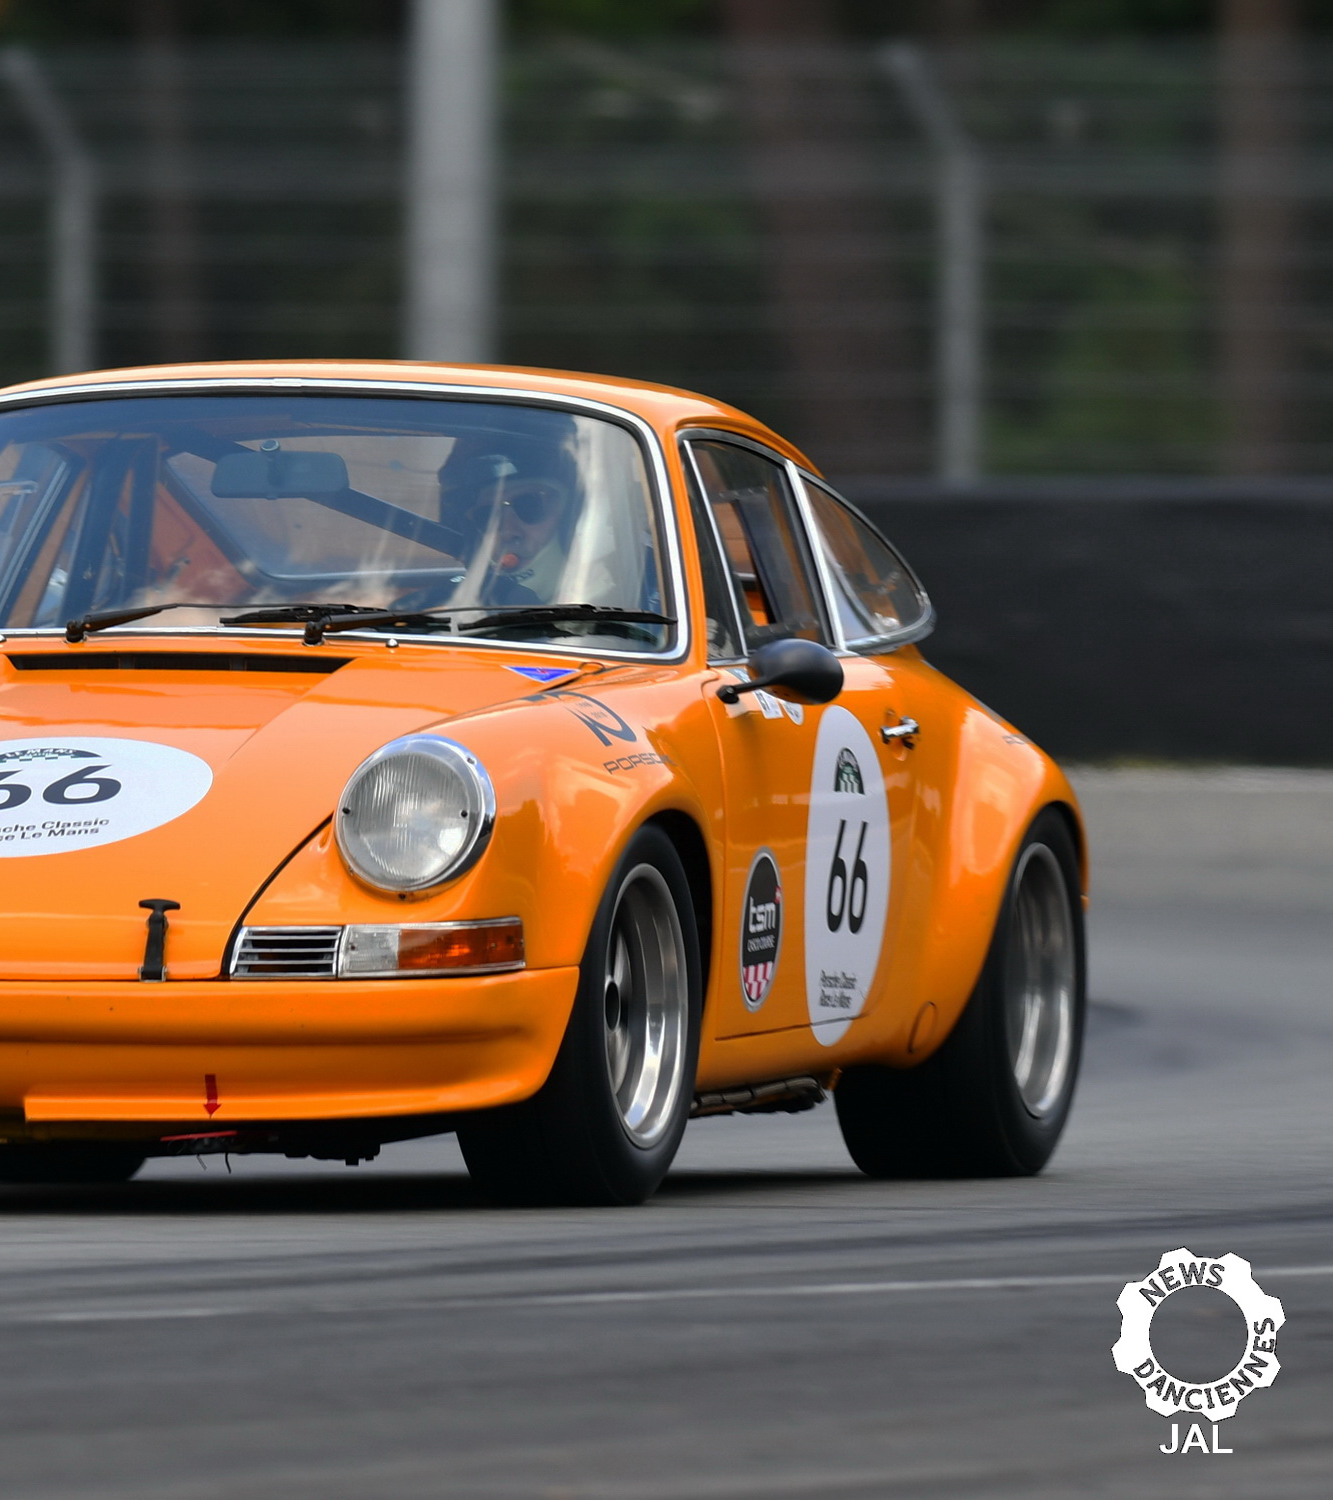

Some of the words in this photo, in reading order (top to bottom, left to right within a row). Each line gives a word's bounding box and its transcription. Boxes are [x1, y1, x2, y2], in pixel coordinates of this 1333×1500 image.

[20, 831, 42, 840] Le
[47, 827, 100, 837] Mans
[41, 817, 109, 831] Classic
[827, 819, 868, 934] 66
[749, 896, 776, 934] tsm
